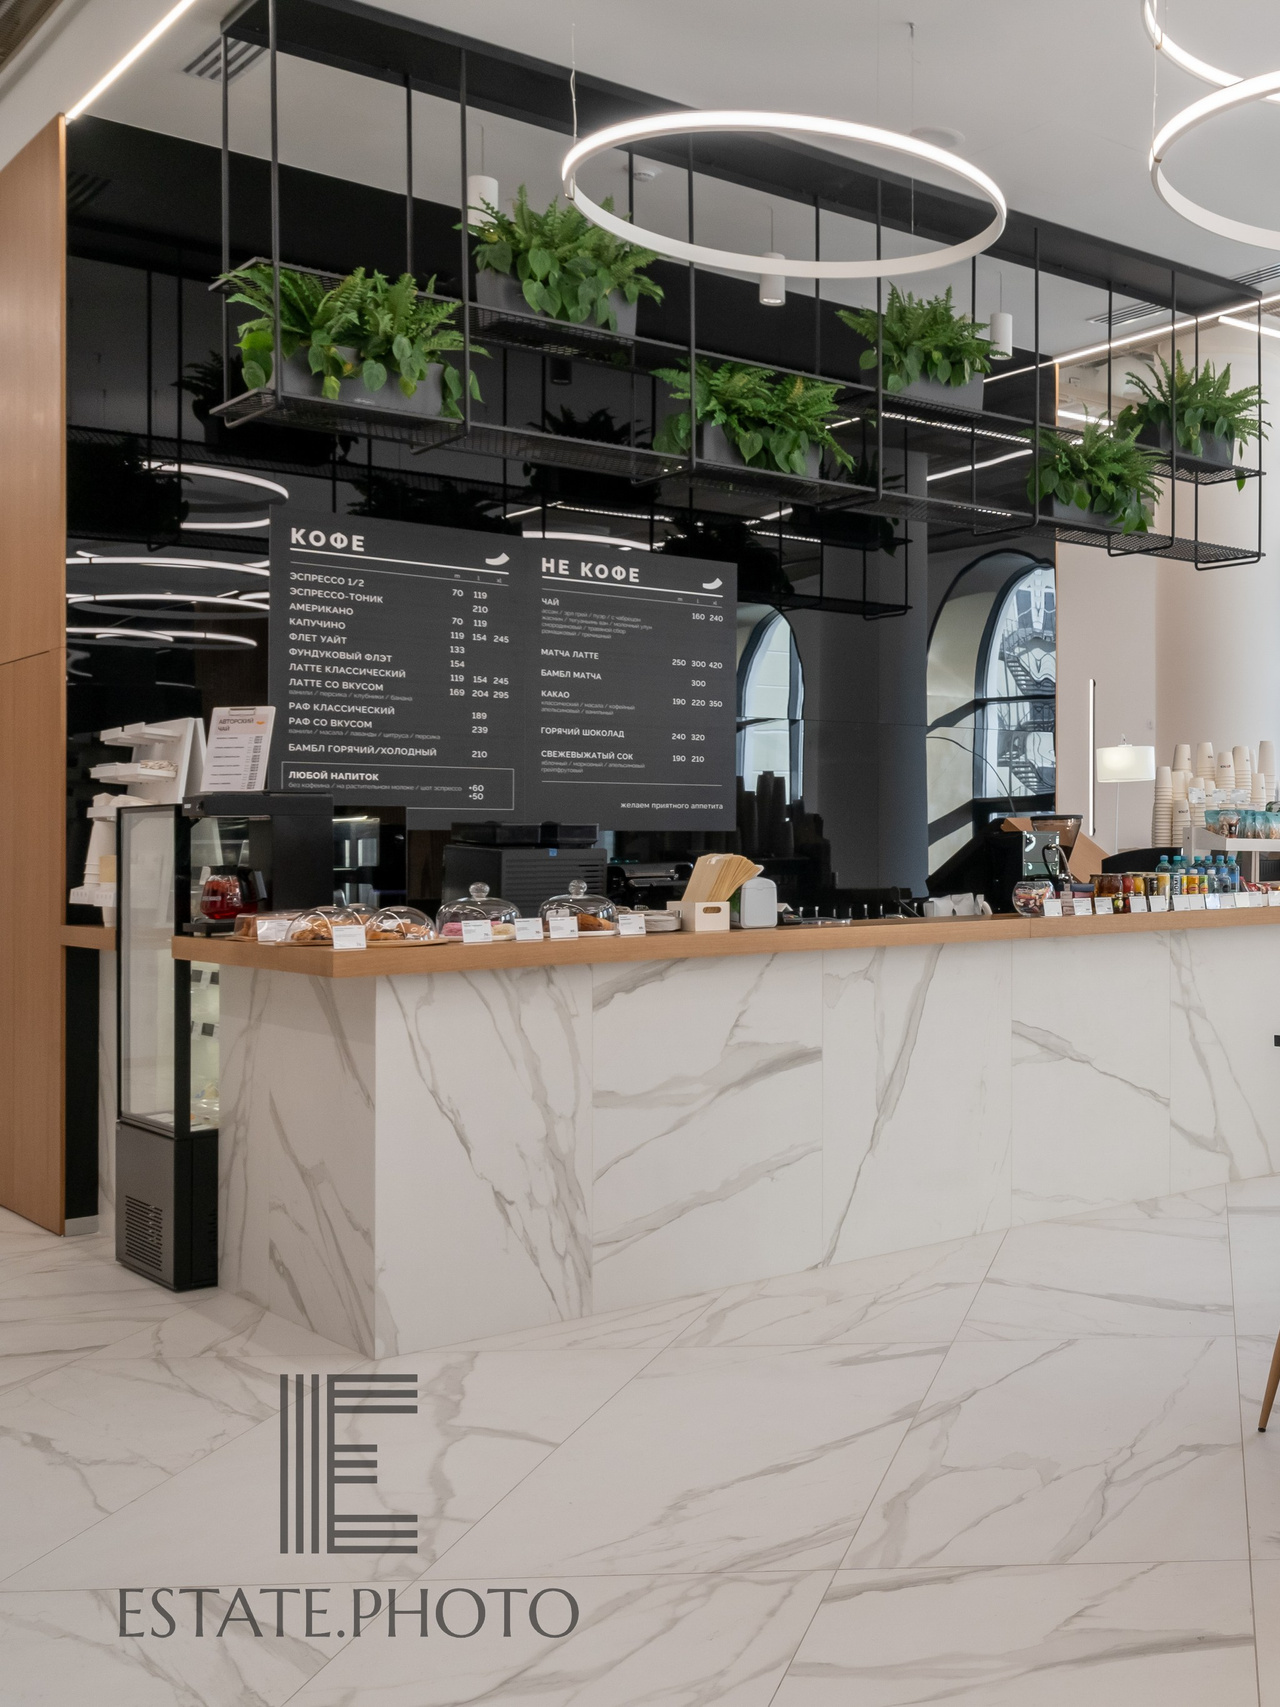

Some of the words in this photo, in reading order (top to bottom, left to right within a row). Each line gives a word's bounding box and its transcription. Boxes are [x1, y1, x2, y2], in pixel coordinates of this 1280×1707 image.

[291, 527, 365, 552] КОФЕ
[541, 557, 570, 575] НЕ
[581, 561, 640, 583] КОФЕ
[290, 572, 346, 585] ЭСПРЕССО
[347, 578, 365, 587] 1/2
[452, 589, 463, 597] 70
[473, 591, 487, 599] 119
[290, 587, 383, 603] ЭСПРЕССО-ТОНИК
[472, 605, 488, 614] 210
[542, 597, 560, 606] ЧАЙ
[692, 612, 705, 620] 160
[709, 614, 724, 622] 240
[289, 603, 354, 616] АМЕРИКАНО
[452, 617, 463, 626] 70
[473, 619, 487, 628] 119
[289, 617, 346, 630] КАПУЧИНО
[450, 631, 465, 640] 119
[472, 633, 487, 642] 154
[493, 635, 509, 644] 245
[289, 632, 317, 643] ФЛЕТ
[320, 634, 347, 645] УАЙТ
[450, 645, 465, 654] 133
[289, 647, 362, 661] ФУНДУКОВЫЙ
[364, 653, 392, 663] ФЛЭТ
[450, 660, 465, 668] 154
[541, 649, 570, 658] МАТЧА
[572, 651, 599, 660] ЛАТТЕ
[691, 660, 706, 668] 300
[709, 661, 723, 669] 420
[288, 663, 322, 673] ЛАТТЕ
[325, 665, 406, 679] КЛАССИЧЕСКИЙ
[450, 674, 465, 682] 119
[473, 675, 488, 684] 154
[493, 677, 509, 685] 245
[541, 669, 571, 678] БАМБЛ
[573, 671, 602, 680] МАТЧА
[288, 678, 322, 689] ЛАТТЕ
[324, 680, 340, 689] СО
[342, 681, 384, 691] ВКУСОМ
[450, 688, 465, 697] 169
[472, 690, 489, 698] 204
[493, 690, 509, 699] 295
[541, 690, 570, 699] КАКАО
[672, 698, 686, 706] 190
[691, 699, 706, 707] 220
[709, 700, 723, 708] 350
[288, 702, 311, 712] РАФ
[313, 702, 395, 715] КЛАССИЧЕСКИЙ
[472, 711, 487, 720] 189
[288, 717, 311, 727] РАФ
[313, 718, 328, 727] СО
[330, 719, 372, 729] ВКУСОМ
[471, 726, 488, 734] 239
[541, 727, 580, 736] ГОРЯЧИЙ
[582, 729, 624, 738] ШОКОЛАД
[671, 733, 686, 741] 240
[288, 743, 325, 753] БАМБЛ
[328, 744, 437, 757] ГОРЯЧИЙ/ХОЛОДНЫЙ
[471, 750, 488, 759] 210
[541, 750, 615, 760] СВЕЖЕВЫЖАТЫЙ
[617, 752, 633, 760] СОК
[672, 754, 686, 762] 190
[691, 755, 705, 763] 210
[288, 770, 328, 780] ЛЮБОЙ
[331, 772, 379, 781] НАПИТОК
[651, 802, 689, 810] приятного
